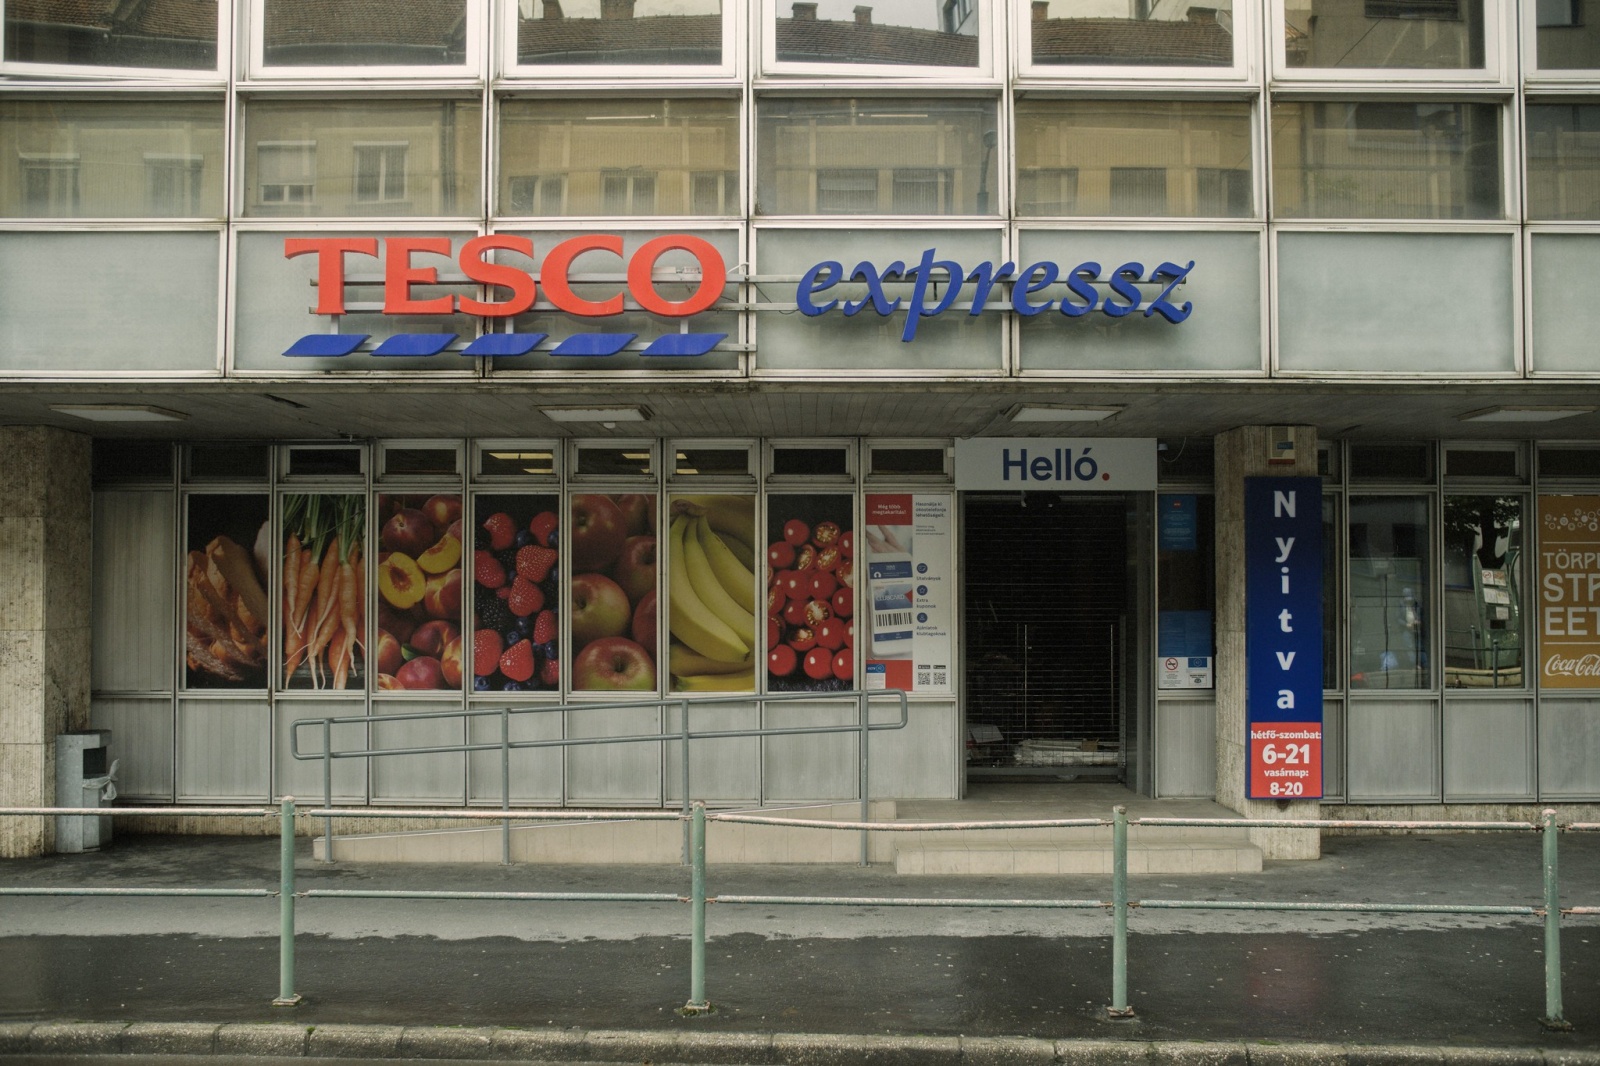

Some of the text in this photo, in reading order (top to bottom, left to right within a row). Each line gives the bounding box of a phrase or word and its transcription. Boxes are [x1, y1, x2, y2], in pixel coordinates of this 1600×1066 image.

[285, 234, 1195, 342] TESCO expressz
[1003, 447, 1110, 482] Helló.
[1272, 489, 1297, 710] Nyitva
[1262, 744, 1311, 765] 6-21
[1263, 767, 1309, 778] vasárnap:
[1269, 781, 1304, 797] 8-20
